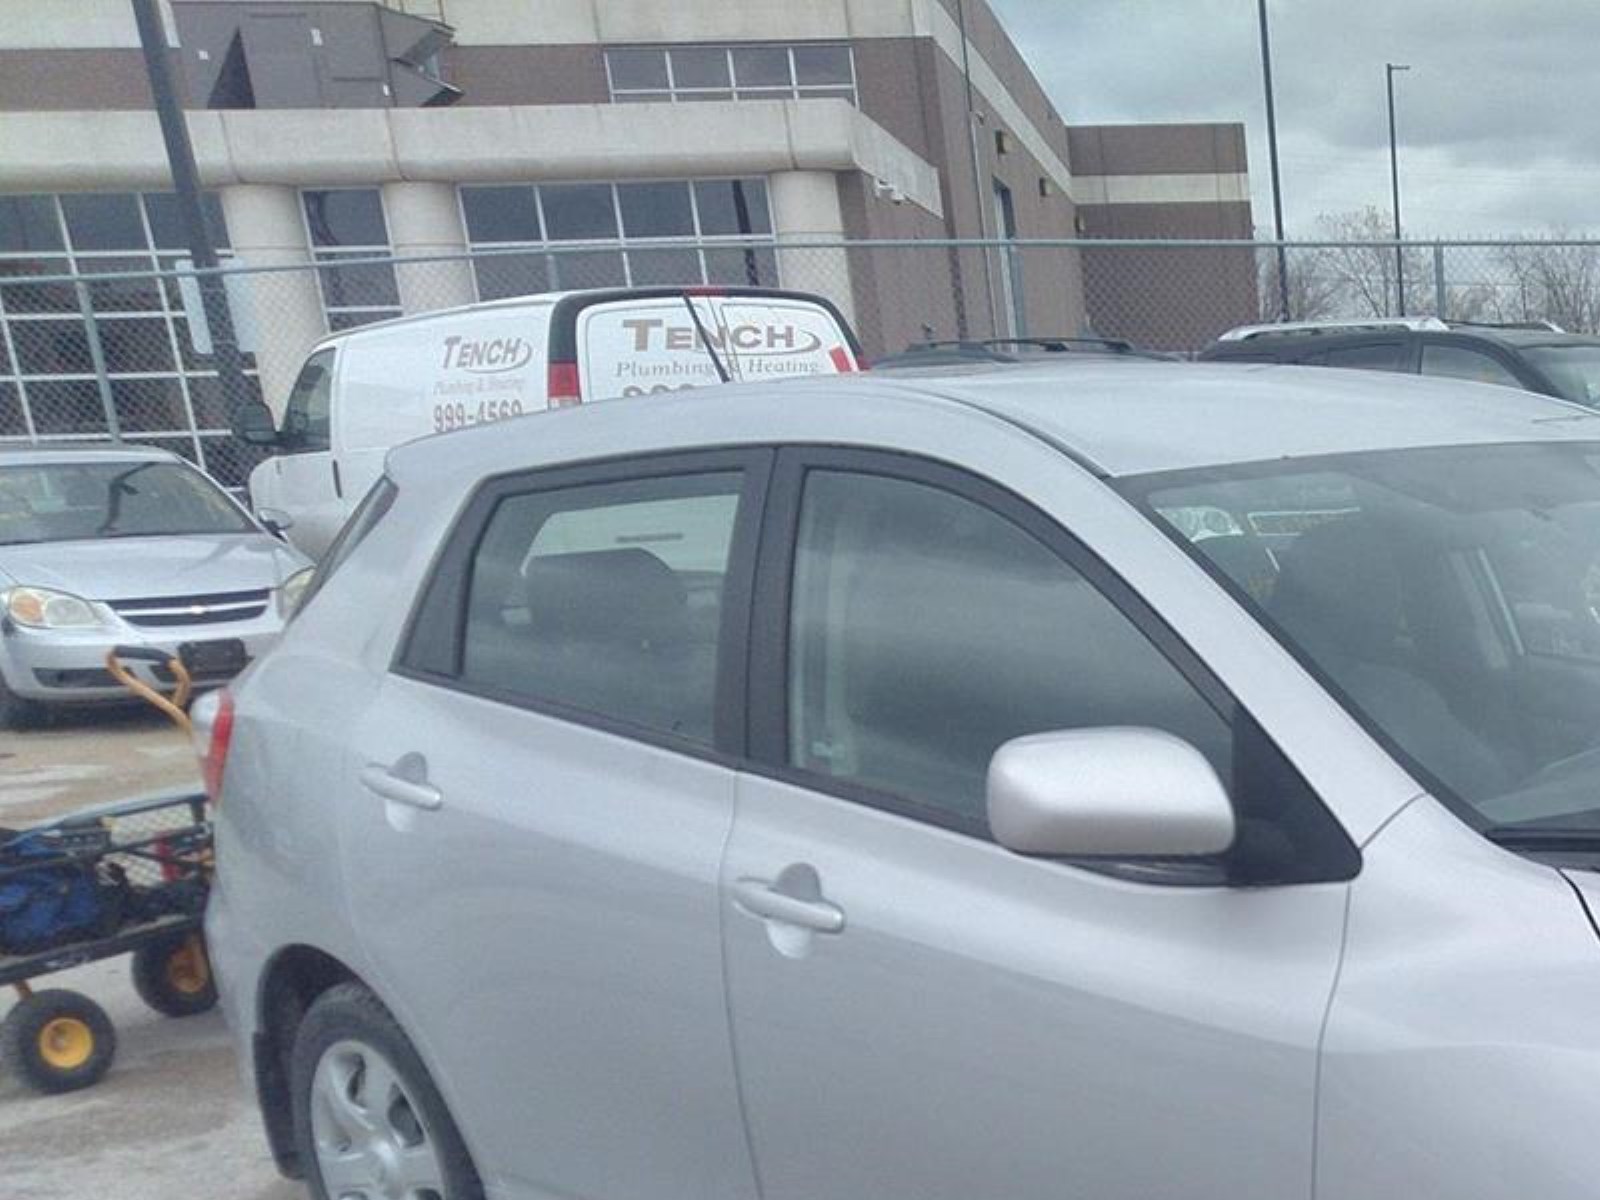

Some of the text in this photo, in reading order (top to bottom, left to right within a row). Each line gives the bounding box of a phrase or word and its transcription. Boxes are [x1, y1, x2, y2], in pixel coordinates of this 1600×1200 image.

[619, 319, 795, 352] TENCH
[443, 335, 523, 370] TENCH
[616, 360, 716, 378] Plumbing
[749, 357, 819, 375] Heating
